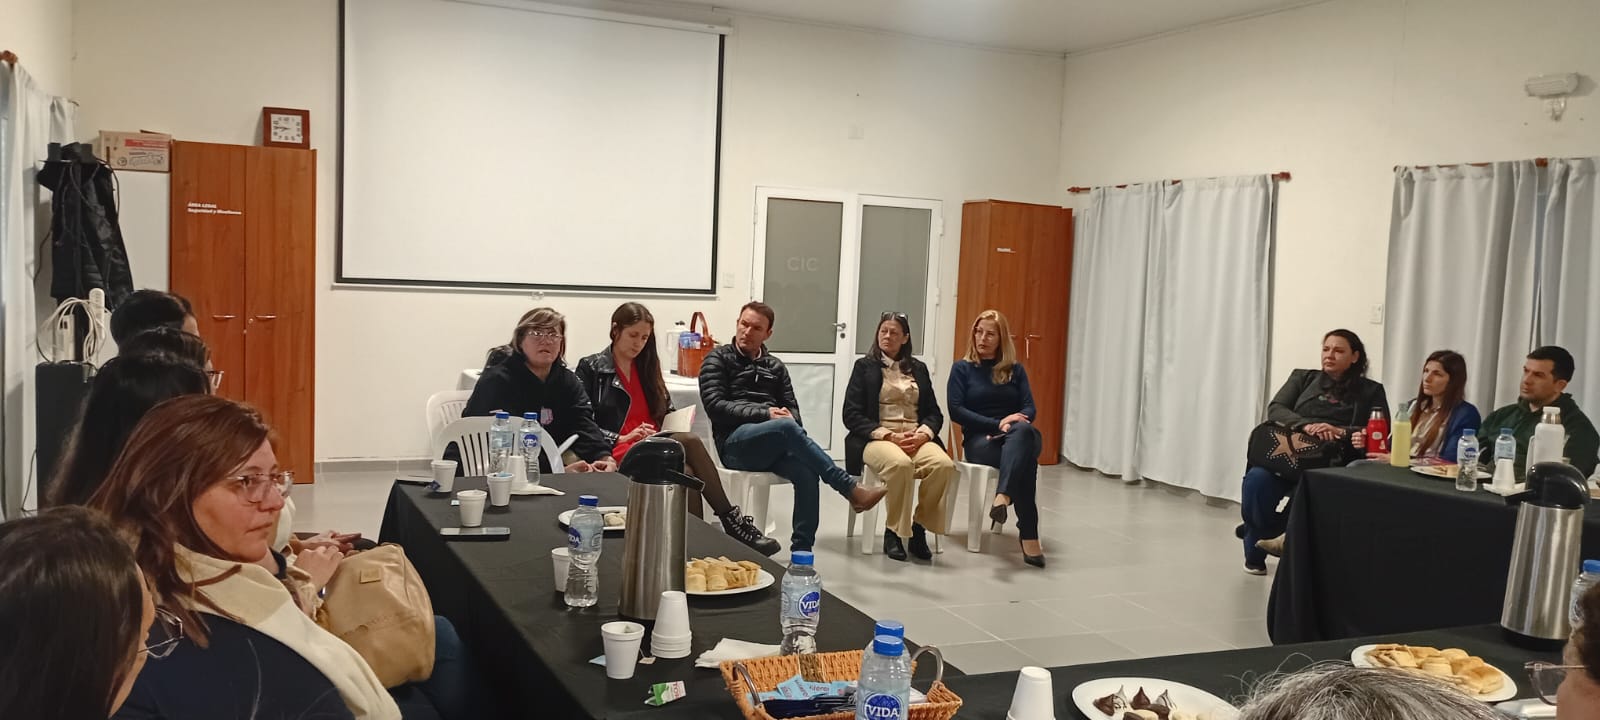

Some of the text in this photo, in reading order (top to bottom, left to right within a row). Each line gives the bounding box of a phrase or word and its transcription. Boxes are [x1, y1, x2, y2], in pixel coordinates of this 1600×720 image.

[787, 257, 818, 271] CIC
[801, 600, 819, 609] VID
[866, 704, 900, 718] VIDA
